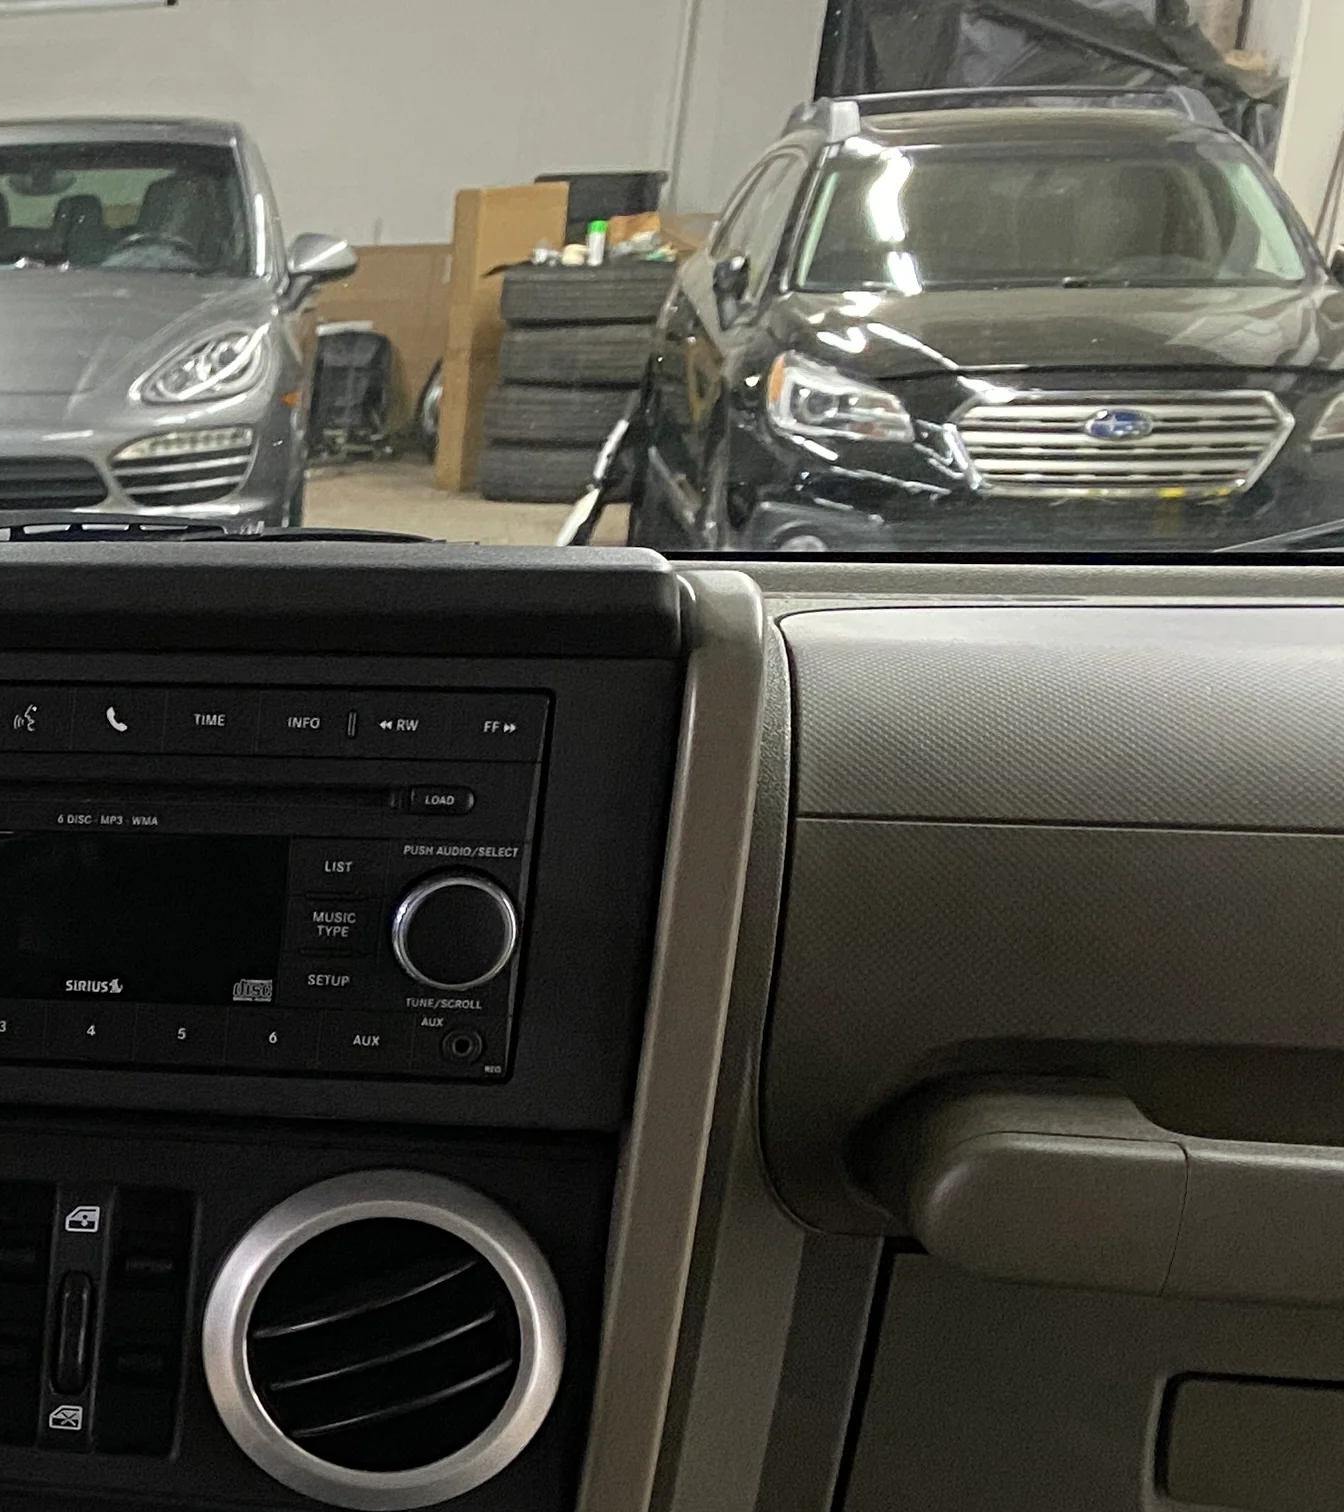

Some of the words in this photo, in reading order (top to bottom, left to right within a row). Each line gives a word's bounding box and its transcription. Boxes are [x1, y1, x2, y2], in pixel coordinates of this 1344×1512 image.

[194, 713, 226, 727] TIME
[287, 717, 321, 730] INFO
[396, 719, 419, 732] RW
[483, 721, 501, 733] FF
[425, 795, 455, 806] LOAD
[67, 815, 92, 825] DISC
[100, 815, 123, 826] MP3
[132, 816, 158, 826] WMA
[403, 845, 434, 856] PUSH
[436, 846, 519, 858] AUDIO/SELECT
[324, 860, 353, 873] LIST
[312, 911, 356, 924] MUSIC
[317, 925, 349, 938] TYPE
[65, 980, 109, 993] SIRIUS
[307, 974, 350, 987] SETUP
[405, 998, 482, 1010] TUNE/SCROLL
[421, 1017, 444, 1027] AUX
[87, 1024, 96, 1036] 4
[177, 1028, 187, 1040] 5
[268, 1031, 278, 1043] 6
[352, 1034, 380, 1047] AUX
